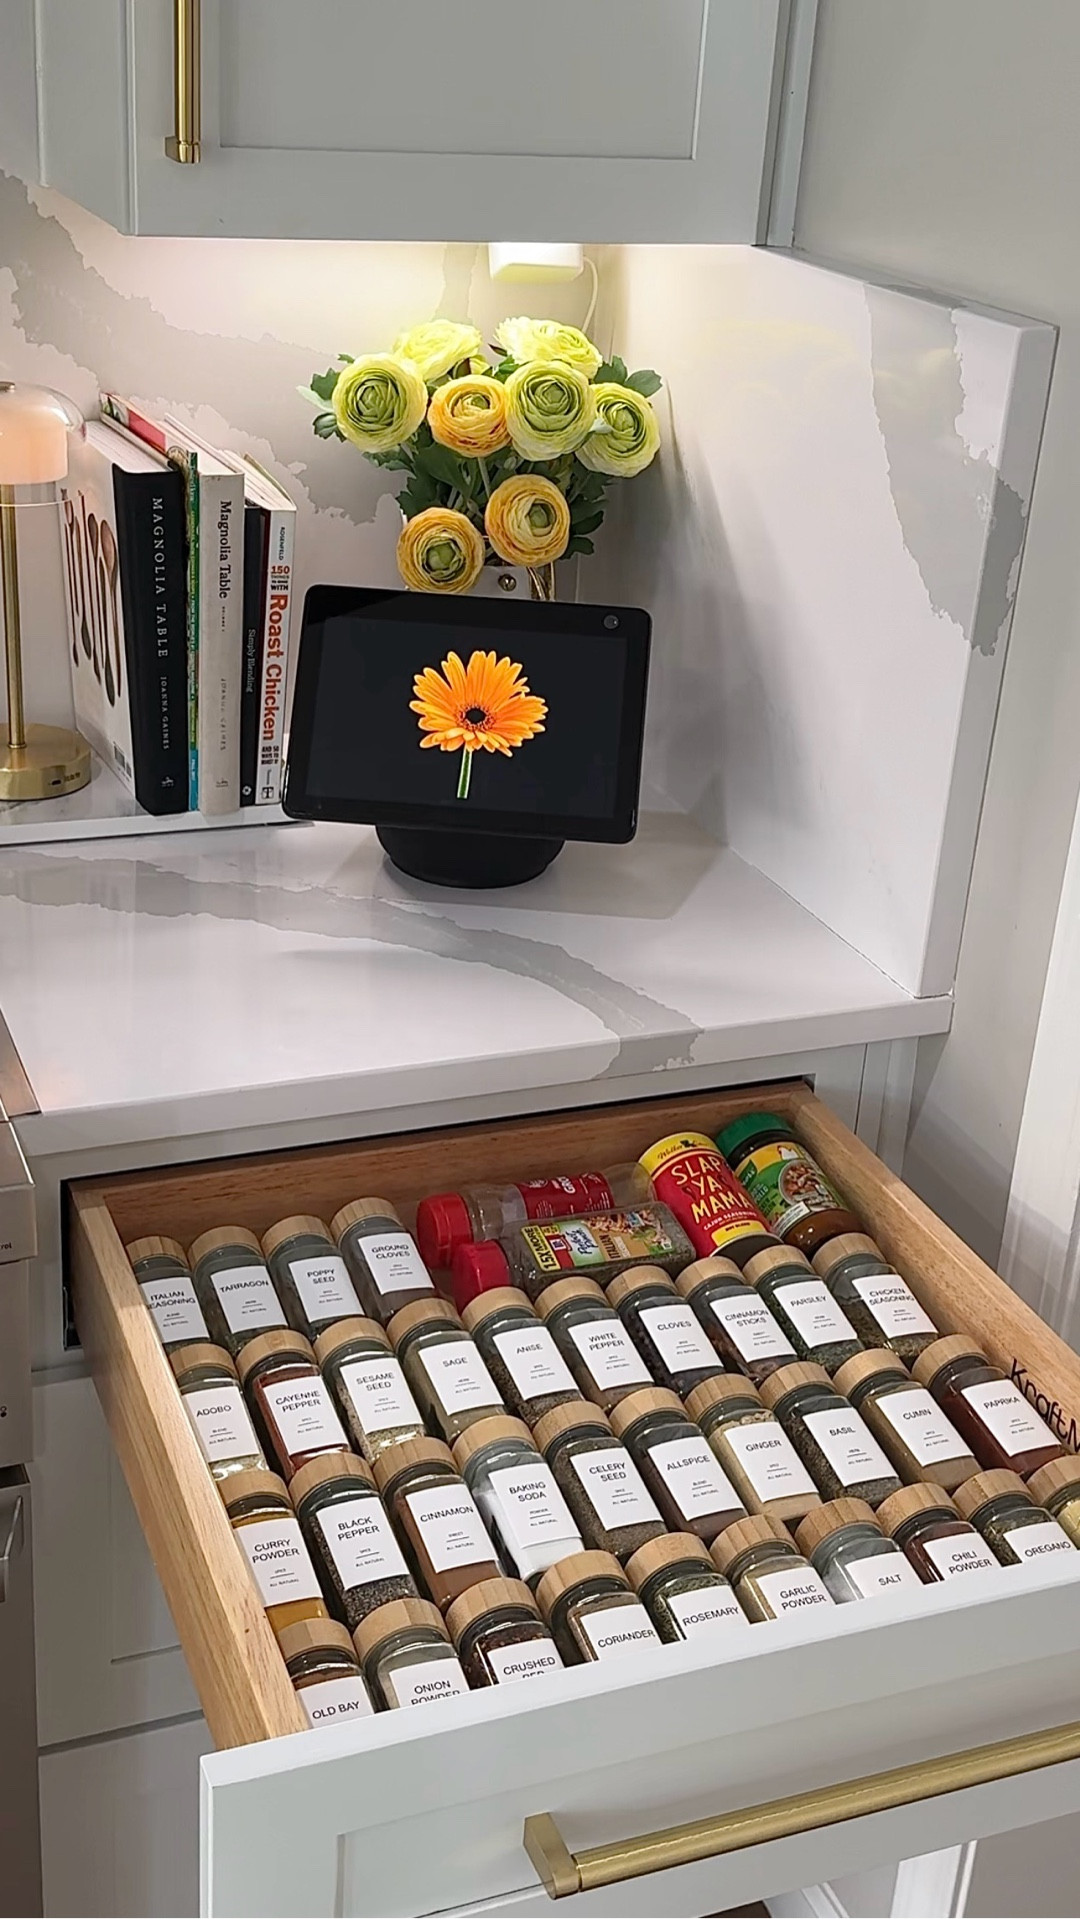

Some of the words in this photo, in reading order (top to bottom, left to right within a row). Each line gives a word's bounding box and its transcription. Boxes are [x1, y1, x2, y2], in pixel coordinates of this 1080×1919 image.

[217, 501, 232, 562] Magnolia
[152, 497, 166, 595] MAGNOLIA
[278, 526, 286, 561] ROSENFELD
[271, 565, 290, 575] 150
[218, 565, 232, 599] Table
[155, 603, 169, 658] TABLE
[267, 594, 288, 659] Roast
[246, 629, 256, 657] Simply
[245, 658, 255, 693] Blending
[160, 676, 168, 713] JOANNA
[262, 664, 283, 742] Chicken
[162, 715, 170, 750] GAINES
[671, 1156, 722, 1185] SLAP
[691, 1175, 723, 1196] YA
[691, 1191, 754, 1224] MAMA
[371, 1244, 409, 1253] GROUND
[376, 1251, 410, 1260] CLOVES
[307, 1269, 335, 1278] POPPY
[313, 1276, 335, 1285] SEED
[220, 1280, 269, 1293] TARRAGON
[869, 1287, 906, 1298] CHICKEN
[150, 1291, 185, 1301] ITALIAN
[790, 1295, 827, 1307] PARSLEY
[868, 1295, 915, 1306] SEASONING
[149, 1298, 196, 1309] EASONING
[724, 1309, 769, 1321] CINNAMON
[736, 1317, 767, 1327] STICKS
[657, 1320, 692, 1331] CLOVES
[588, 1332, 617, 1343] WHITE
[516, 1343, 543, 1354] ANISE
[589, 1340, 625, 1351] PEPPER
[442, 1357, 468, 1368] SAGE
[356, 1372, 395, 1385] SESAME
[366, 1381, 392, 1392] SEED
[275, 1390, 320, 1405] CAYENNE
[983, 1396, 1021, 1410] PAPRIKA
[196, 1405, 232, 1417] ADOBO
[282, 1399, 321, 1413] PEPPER
[902, 1407, 932, 1420] CUMIN
[829, 1426, 856, 1437] BASIL
[745, 1439, 782, 1452] GINGER
[589, 1462, 626, 1475] CELERY
[667, 1455, 711, 1471] ALLSPICE
[600, 1471, 627, 1482] SEED
[508, 1481, 547, 1495] BAKING
[517, 1491, 547, 1503] SODA
[420, 1505, 474, 1523] CINNAMON
[337, 1516, 373, 1531] BLACK
[337, 1525, 380, 1542] PEPPER
[254, 1539, 291, 1553] CURRY
[1024, 1541, 1071, 1558] OREGANO
[252, 1547, 300, 1564] POWDER
[951, 1551, 977, 1562] CHILI
[948, 1558, 993, 1574] POWDER
[878, 1573, 903, 1586] SALT
[780, 1585, 817, 1599] GARLIC
[781, 1594, 827, 1611] POWDER
[682, 1606, 740, 1627] ROSEMARY
[597, 1629, 656, 1648] CORIANDER
[503, 1656, 556, 1676] CRUSHED
[414, 1680, 452, 1695] ONION
[312, 1705, 336, 1720] OLD
[338, 1700, 361, 1714] BAY
